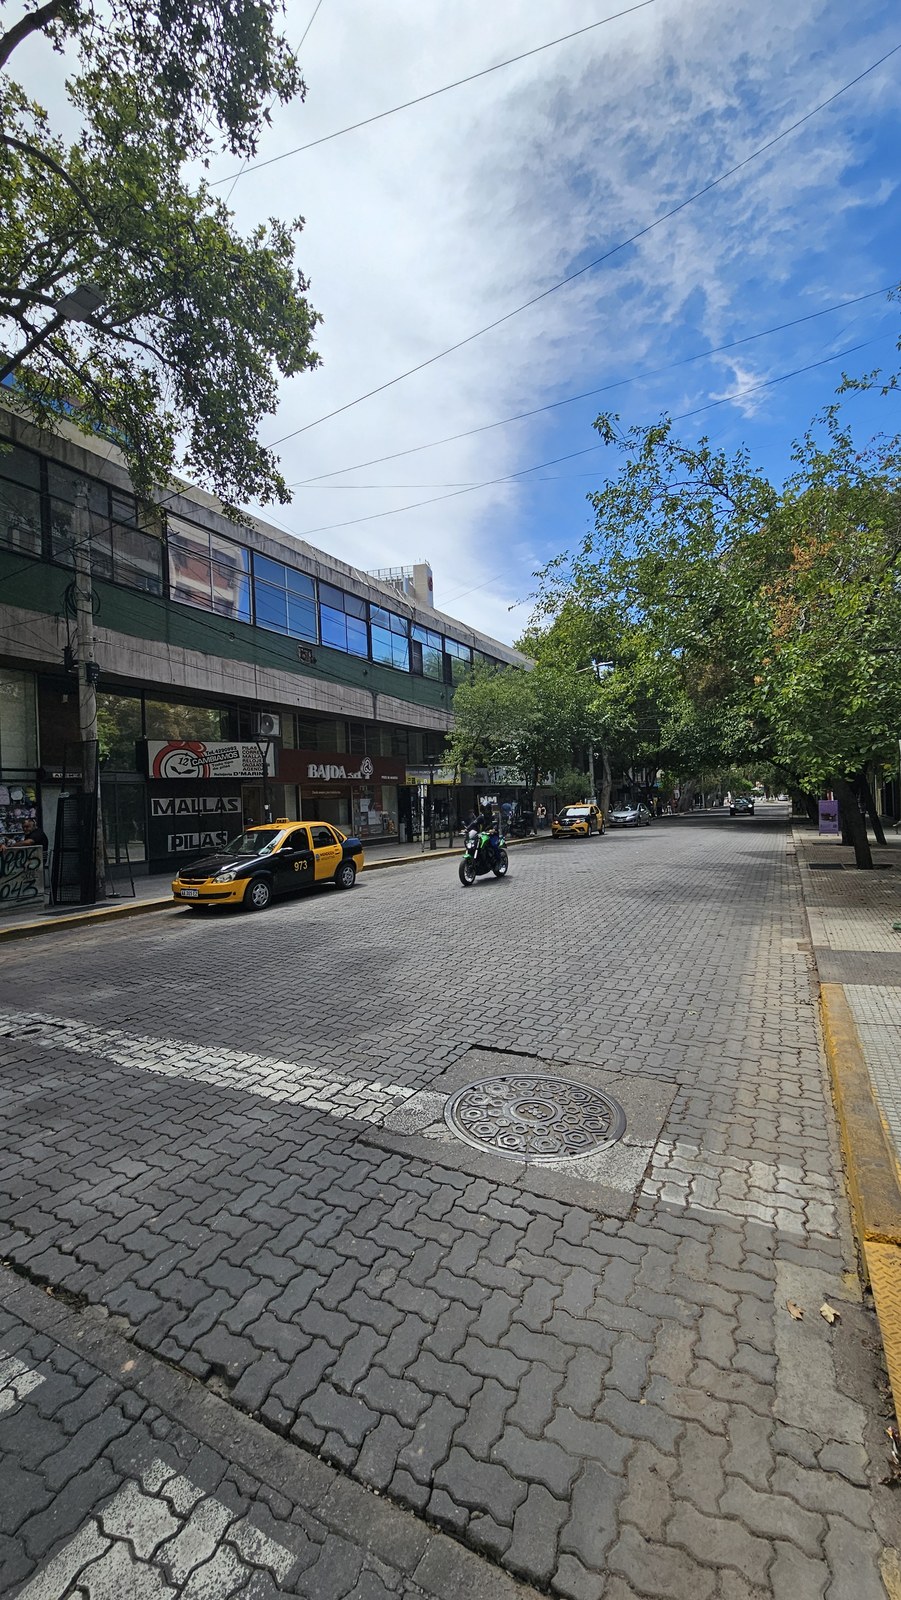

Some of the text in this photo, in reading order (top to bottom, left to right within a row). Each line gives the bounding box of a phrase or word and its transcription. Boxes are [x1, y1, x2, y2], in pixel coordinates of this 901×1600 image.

[178, 757, 190, 767] 12
[192, 752, 239, 766] CAMBIAMOS
[307, 764, 347, 782] BAJDA
[152, 798, 238, 815] MALLAS
[170, 832, 227, 851] PILAS
[294, 859, 308, 872] 973
